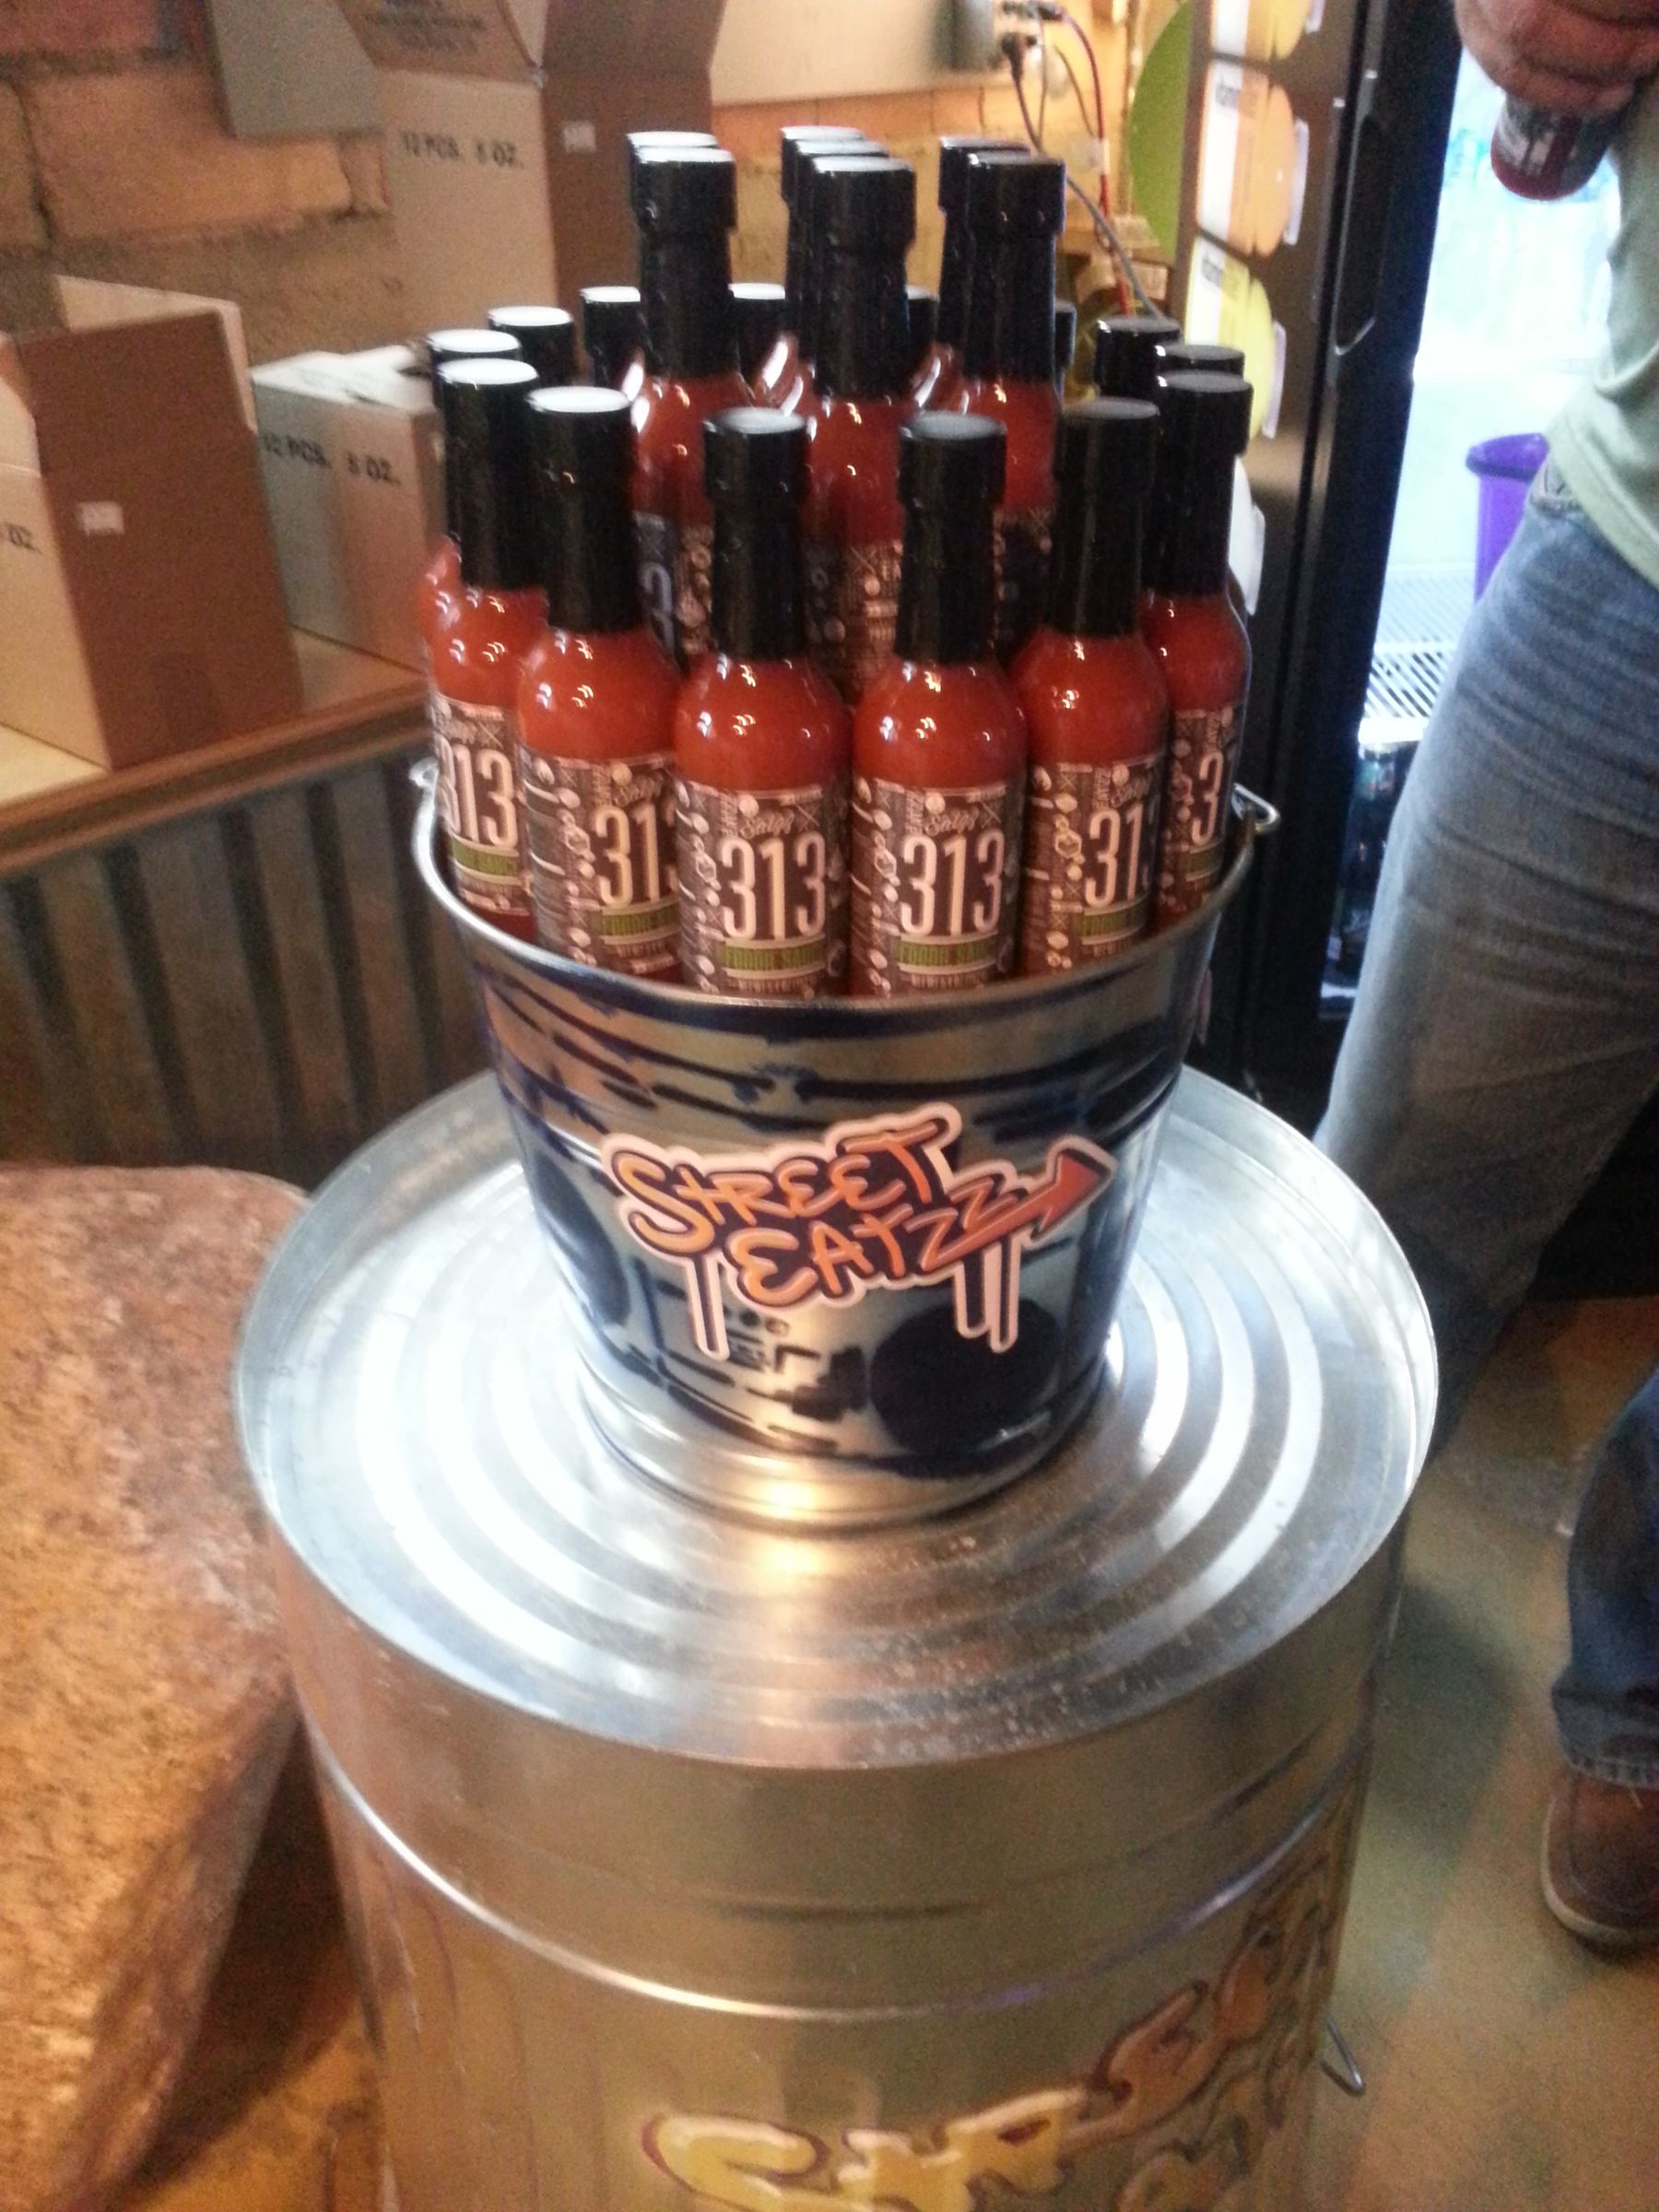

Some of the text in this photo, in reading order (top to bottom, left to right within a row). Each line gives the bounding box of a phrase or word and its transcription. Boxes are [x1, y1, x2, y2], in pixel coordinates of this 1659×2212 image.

[719, 830, 827, 943] 313
[900, 830, 1006, 938] 313
[610, 1116, 944, 1256] STREET
